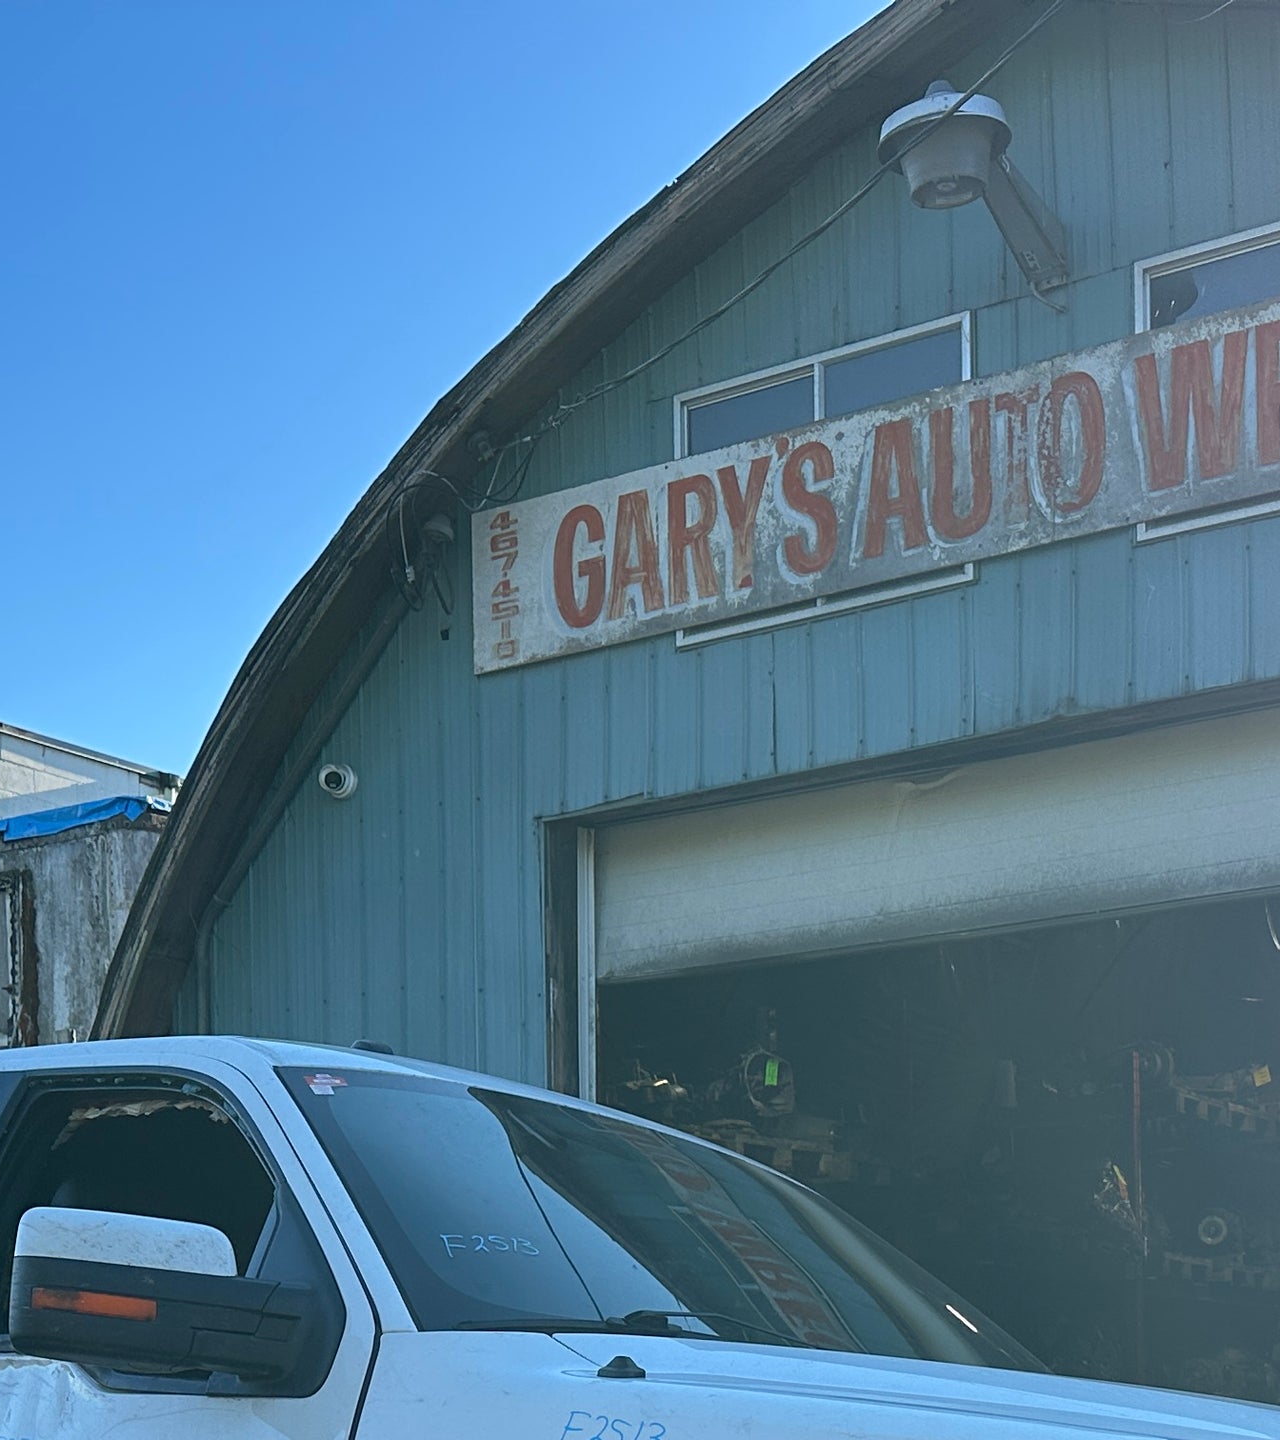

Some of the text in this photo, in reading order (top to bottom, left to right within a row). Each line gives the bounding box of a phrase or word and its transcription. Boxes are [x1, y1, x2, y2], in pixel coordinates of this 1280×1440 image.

[552, 436, 838, 629] GARY'S
[860, 371, 1105, 560] AUTO
[439, 1233, 540, 1259] F2513
